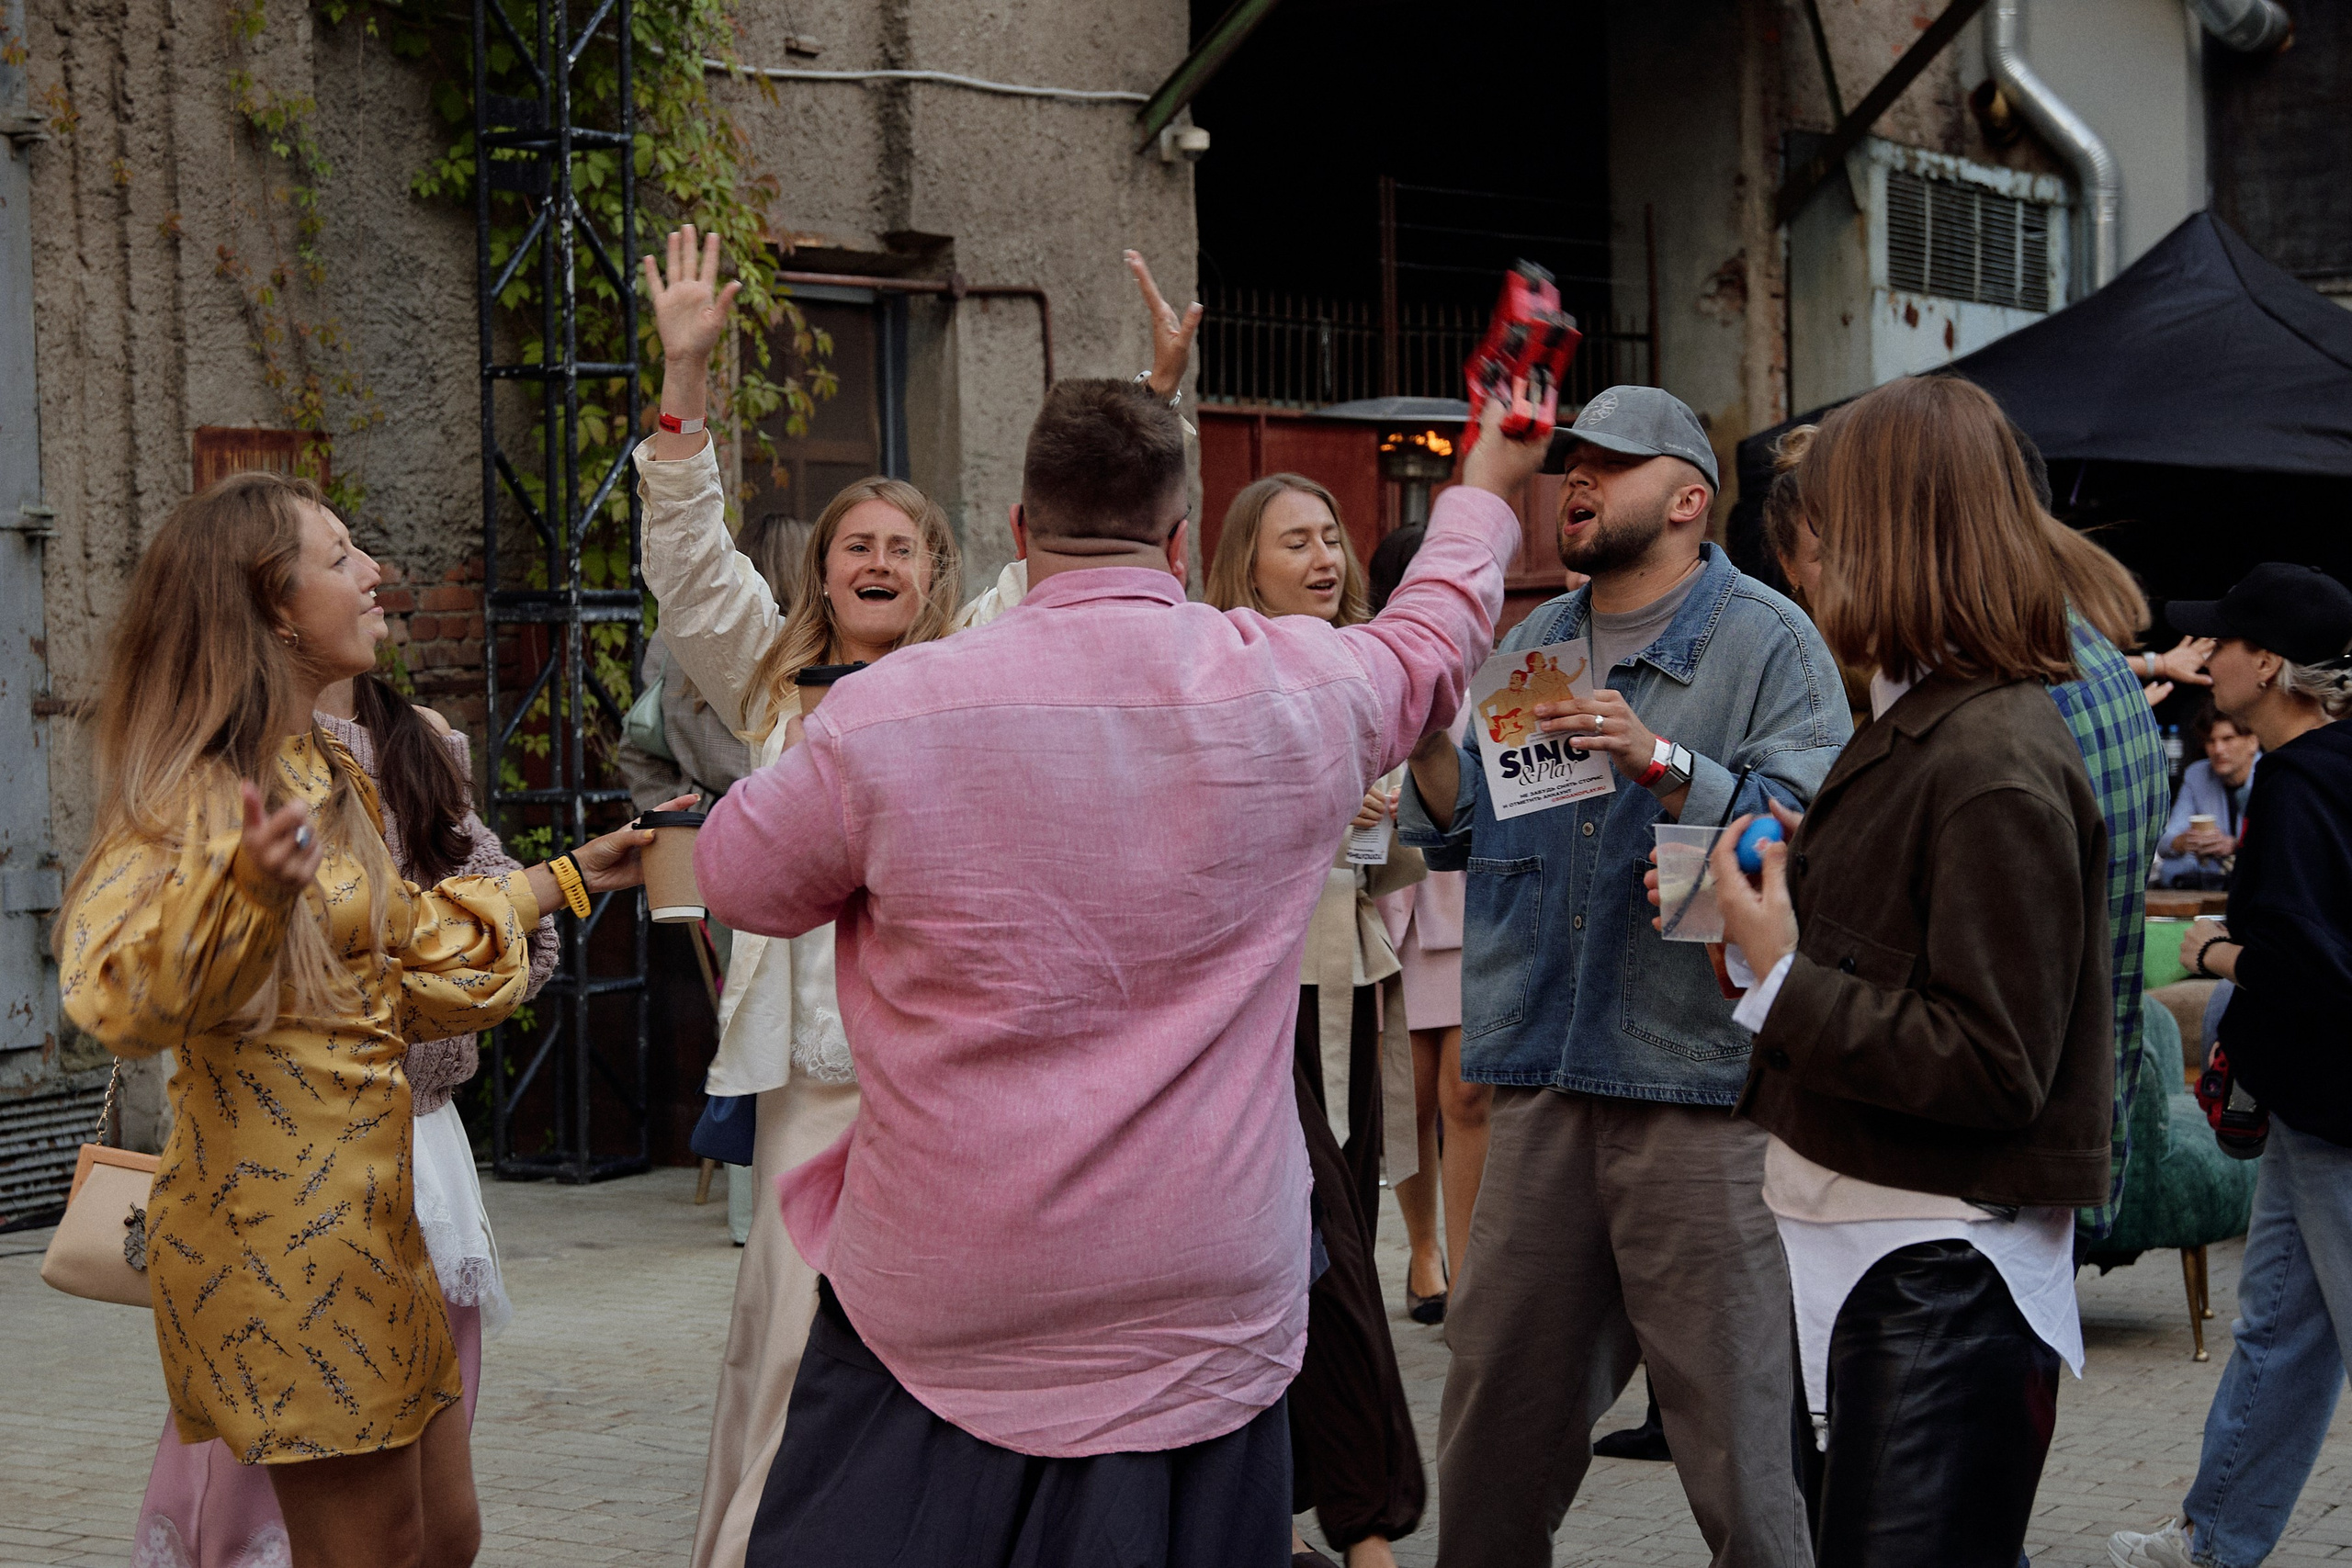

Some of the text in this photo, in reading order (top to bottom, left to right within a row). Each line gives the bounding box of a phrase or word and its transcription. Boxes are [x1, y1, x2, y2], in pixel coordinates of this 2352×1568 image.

[1499, 734, 1590, 779] SING
[1530, 787, 1555, 796] ЗАБУДЬ
[1556, 782, 1577, 790] СНЯТЬ
[1578, 774, 1604, 784] СТОРИС
[1509, 796, 1542, 807] ОТМЕТИТЬ
[1544, 788, 1572, 799] АККАУНТ
